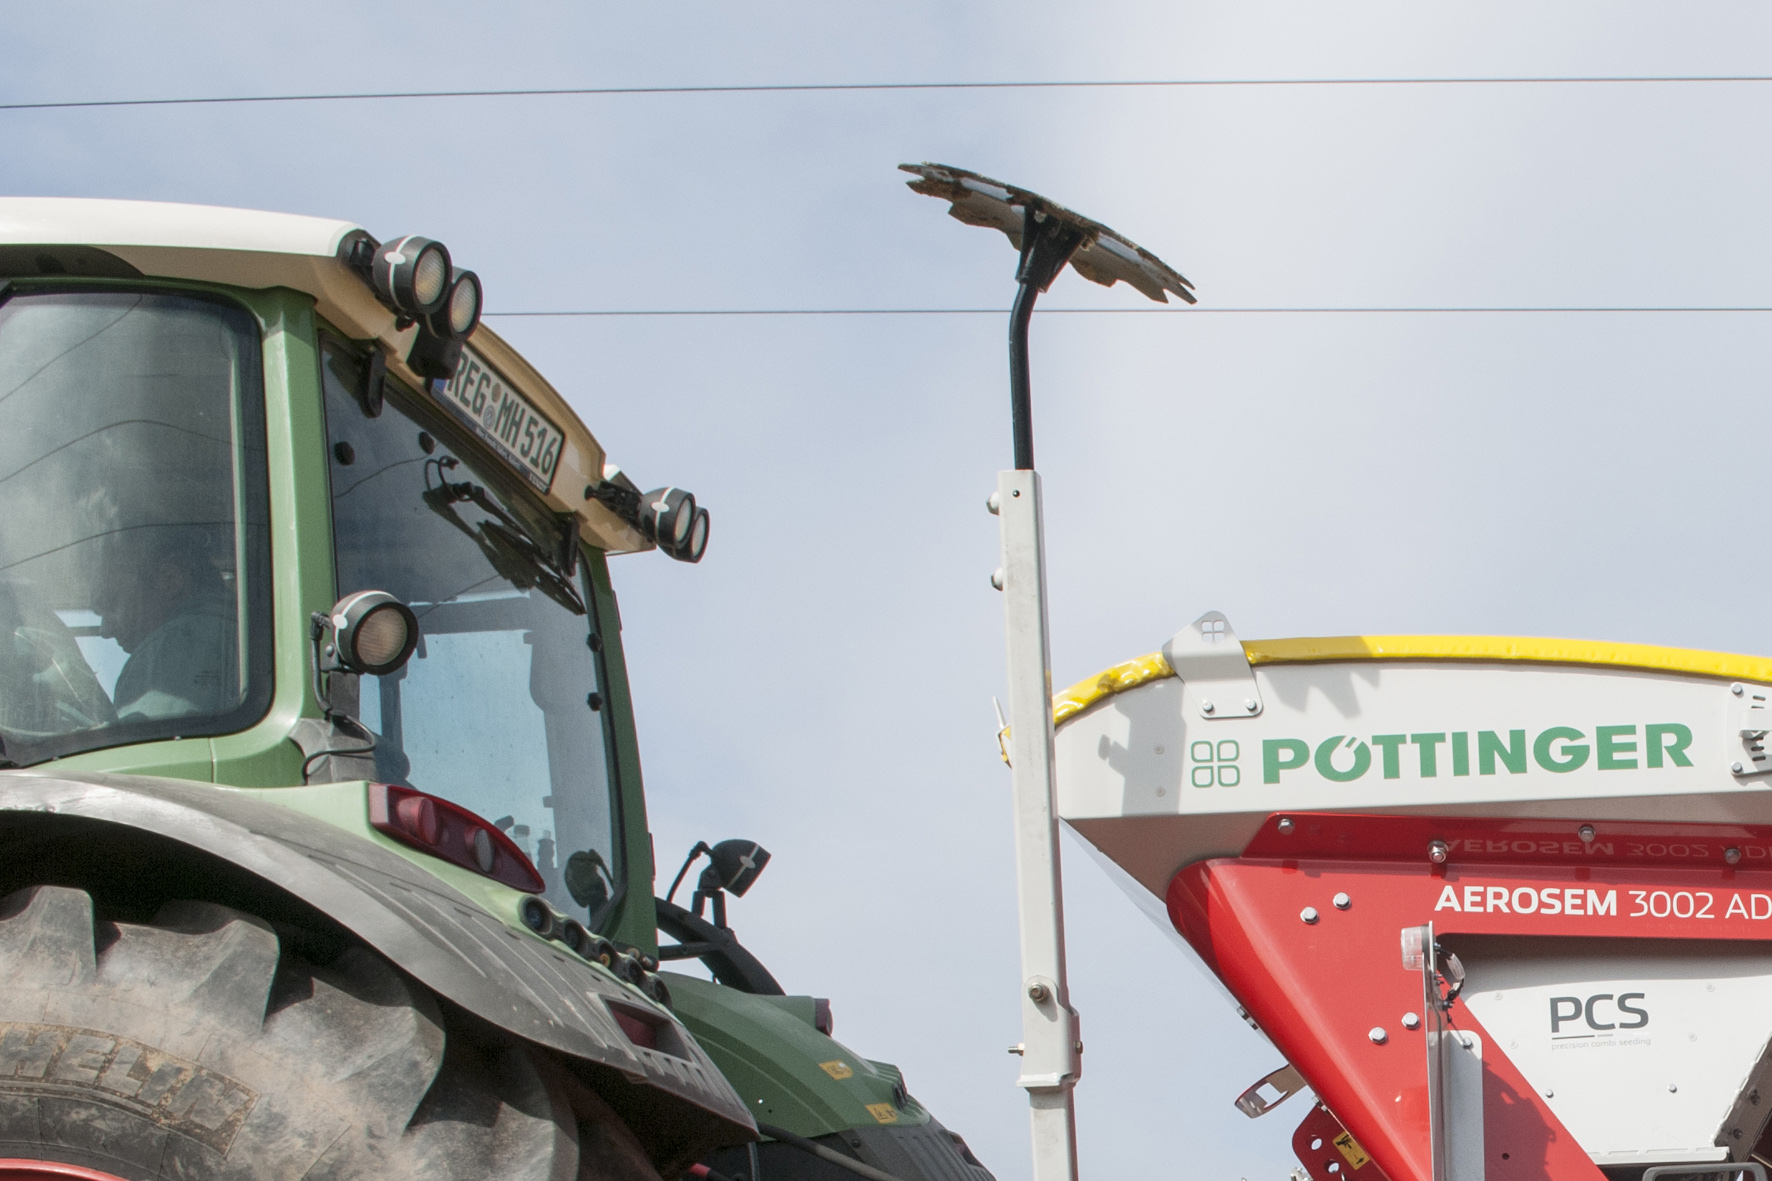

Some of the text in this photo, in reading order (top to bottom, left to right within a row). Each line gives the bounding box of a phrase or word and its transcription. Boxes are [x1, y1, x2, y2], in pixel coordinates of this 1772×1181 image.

[448, 351, 491, 418] REG
[494, 392, 526, 449] MH
[520, 415, 557, 476] 516
[1262, 722, 1695, 784] PÖTTINGER
[1434, 884, 1618, 917] AEROSEM
[1628, 890, 1716, 919] 3002
[1550, 991, 1649, 1034] PCS
[1551, 1037, 1652, 1051] precision combi seeding
